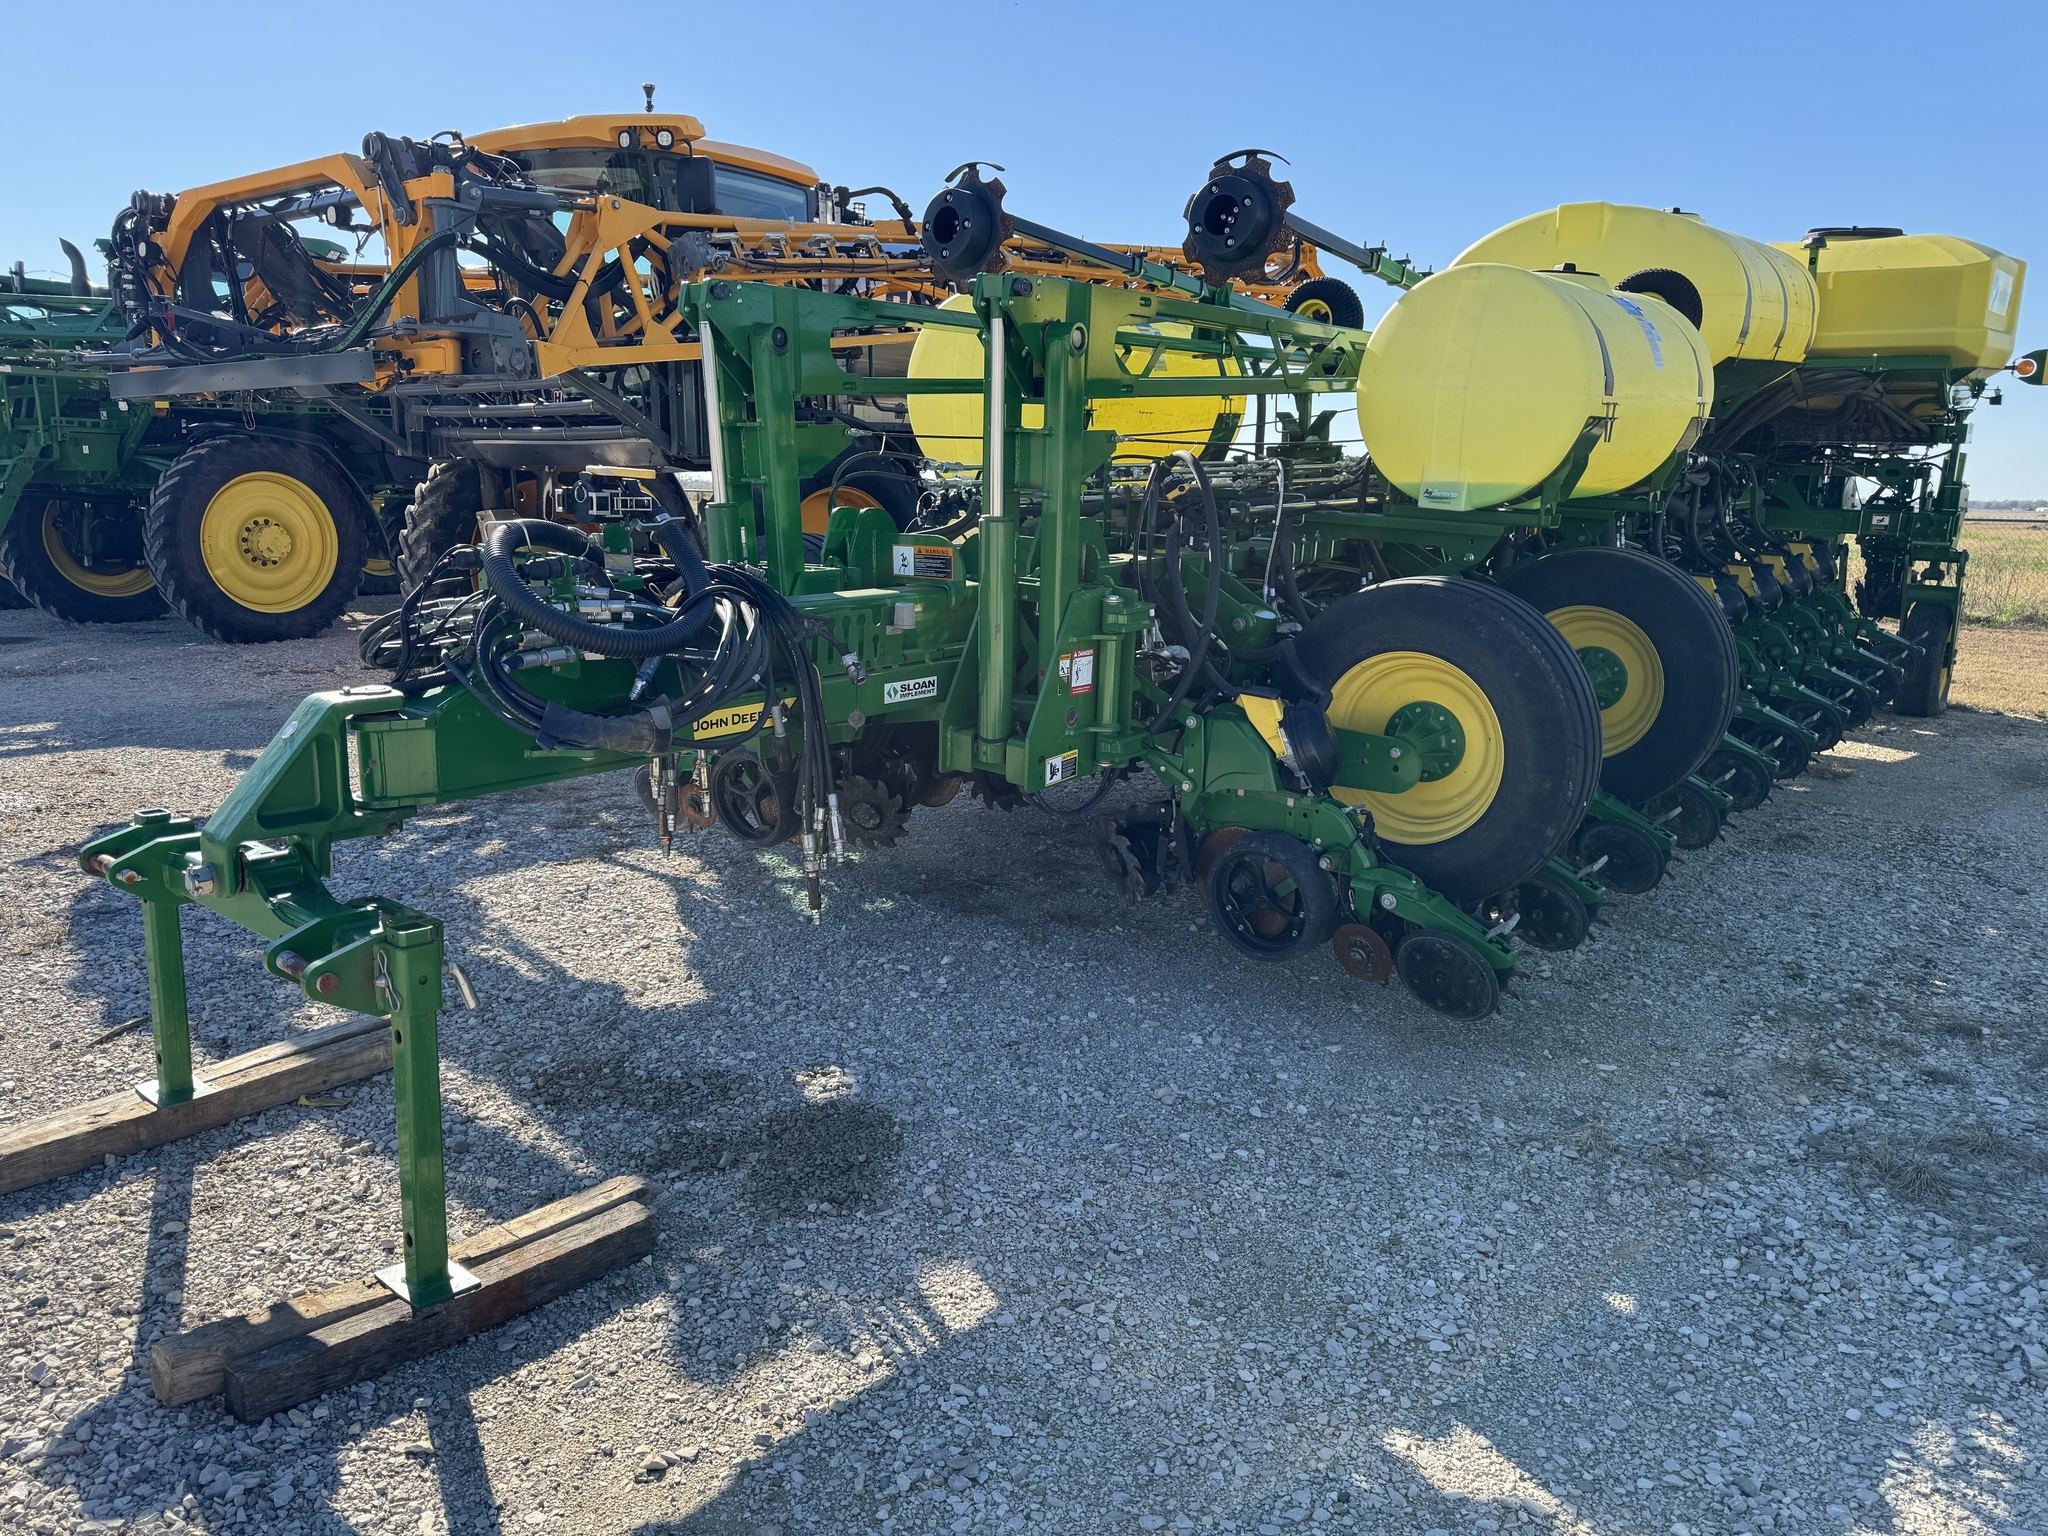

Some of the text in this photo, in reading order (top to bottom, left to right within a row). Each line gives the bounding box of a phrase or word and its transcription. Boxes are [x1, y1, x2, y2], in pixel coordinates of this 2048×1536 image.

[1424, 488, 1458, 498] AgSynergy
[925, 548, 950, 556] WARNING
[1079, 649, 1093, 657] DANGER
[900, 680, 936, 693] SLOAN
[900, 688, 936, 698] IMPLEMENT
[693, 717, 729, 733] JOHN
